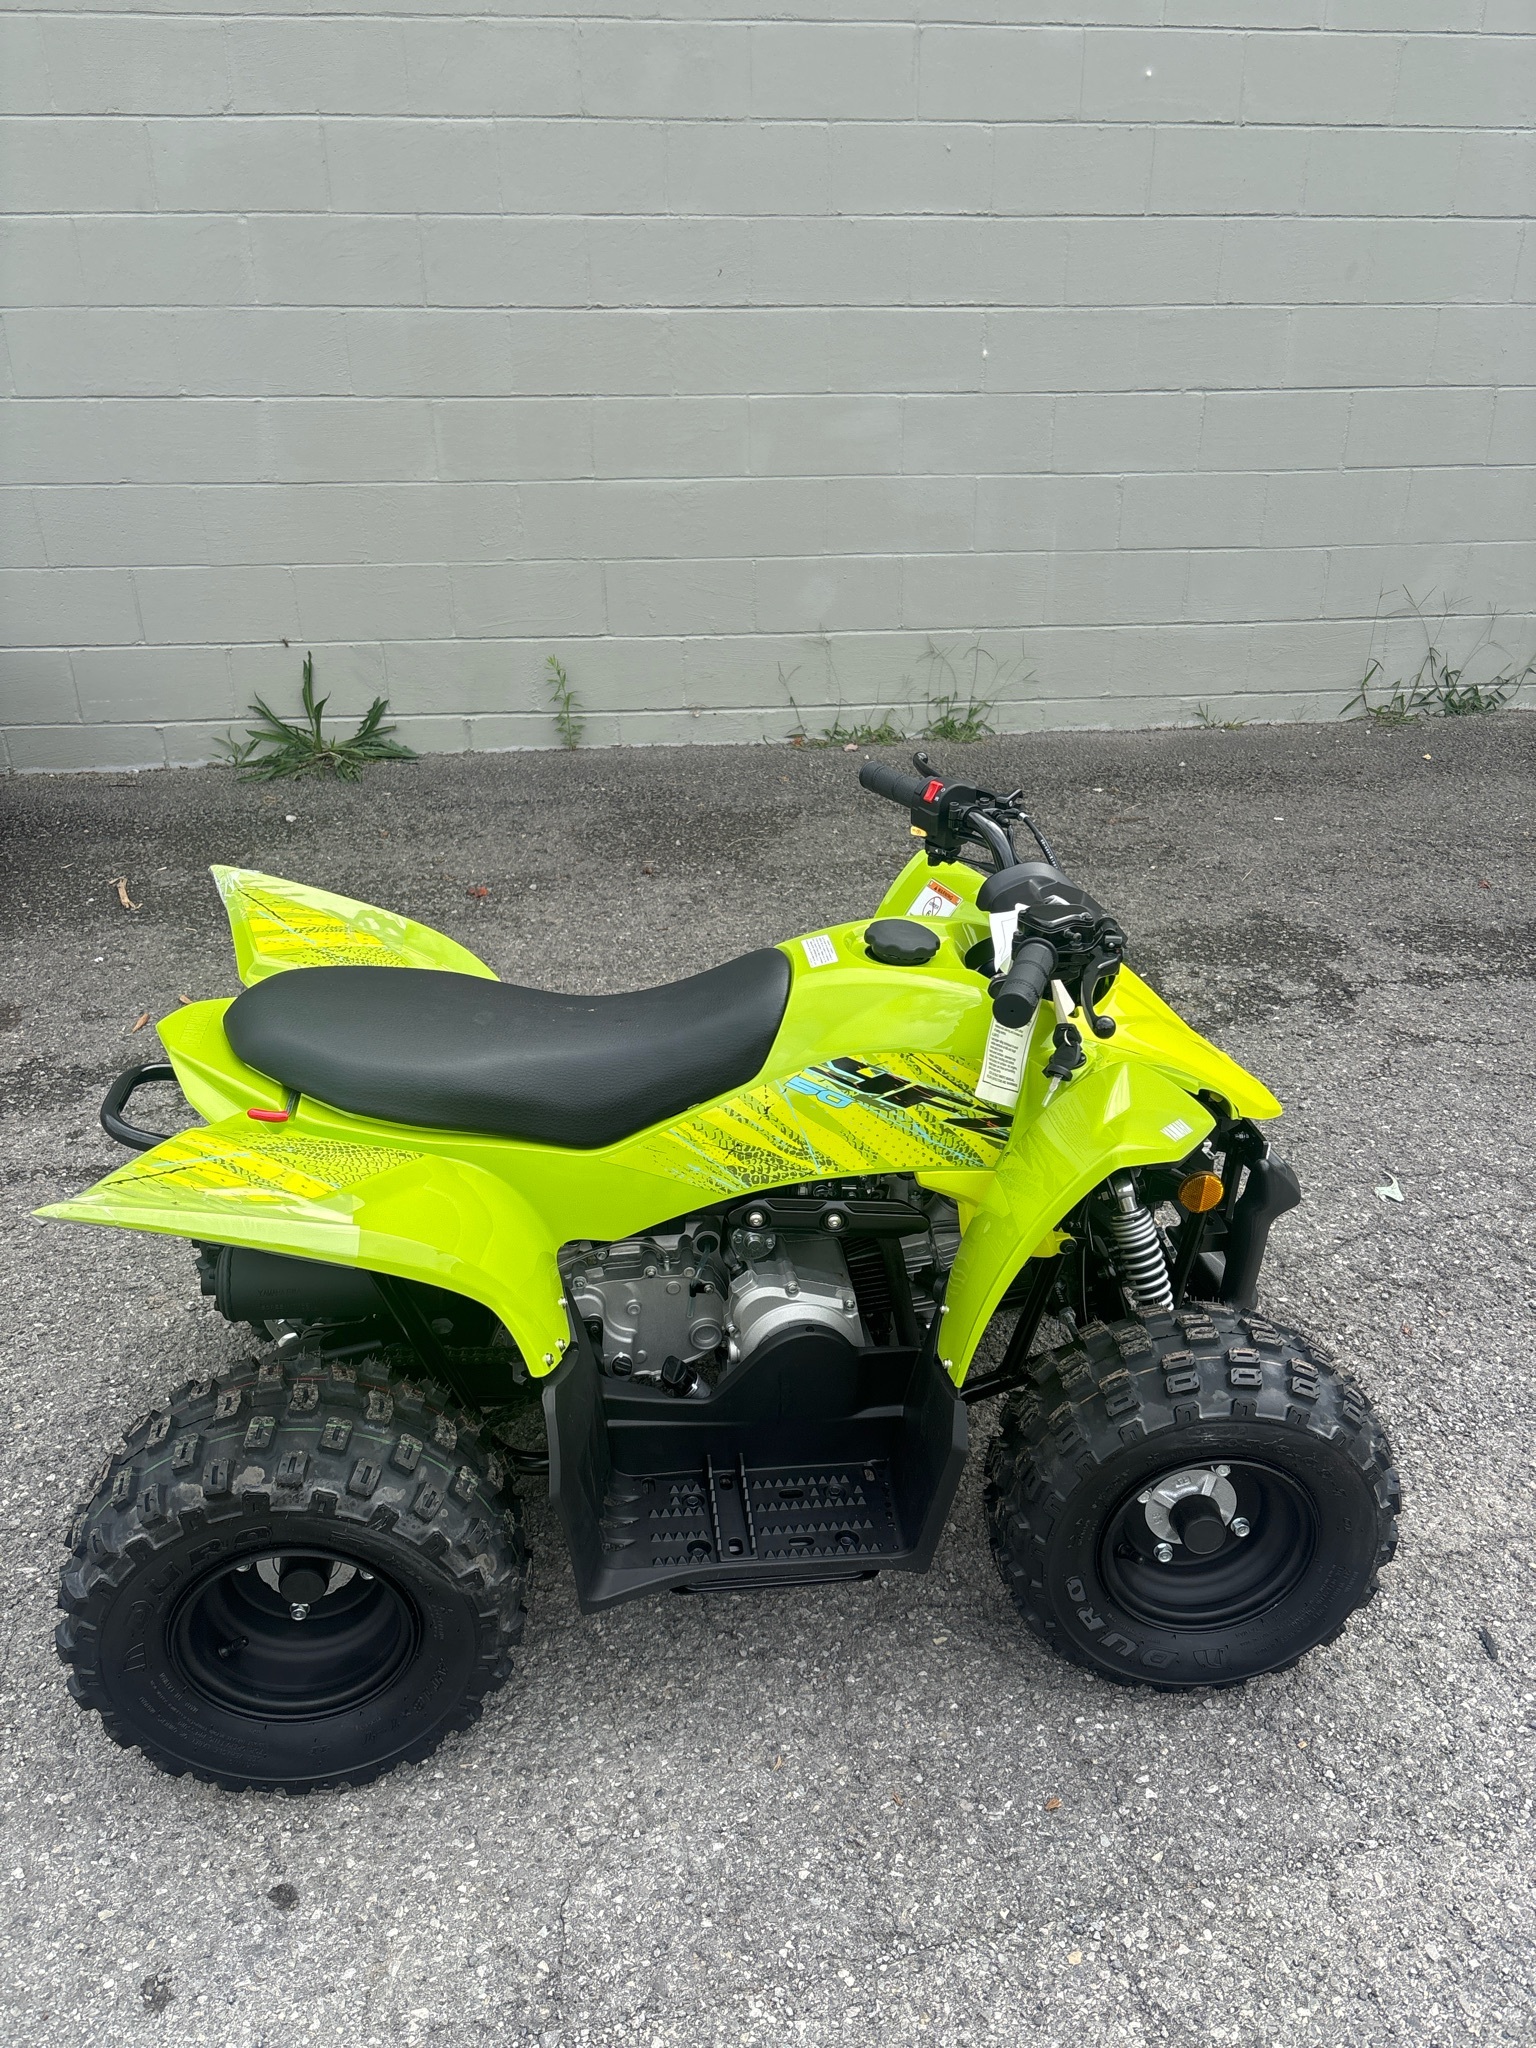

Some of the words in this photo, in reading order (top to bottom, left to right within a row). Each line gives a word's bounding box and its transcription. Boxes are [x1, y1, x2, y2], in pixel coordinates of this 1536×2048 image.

[784, 1075, 853, 1109] 50
[126, 1526, 273, 1628] DURO
[1064, 1575, 1180, 1669] DURO
